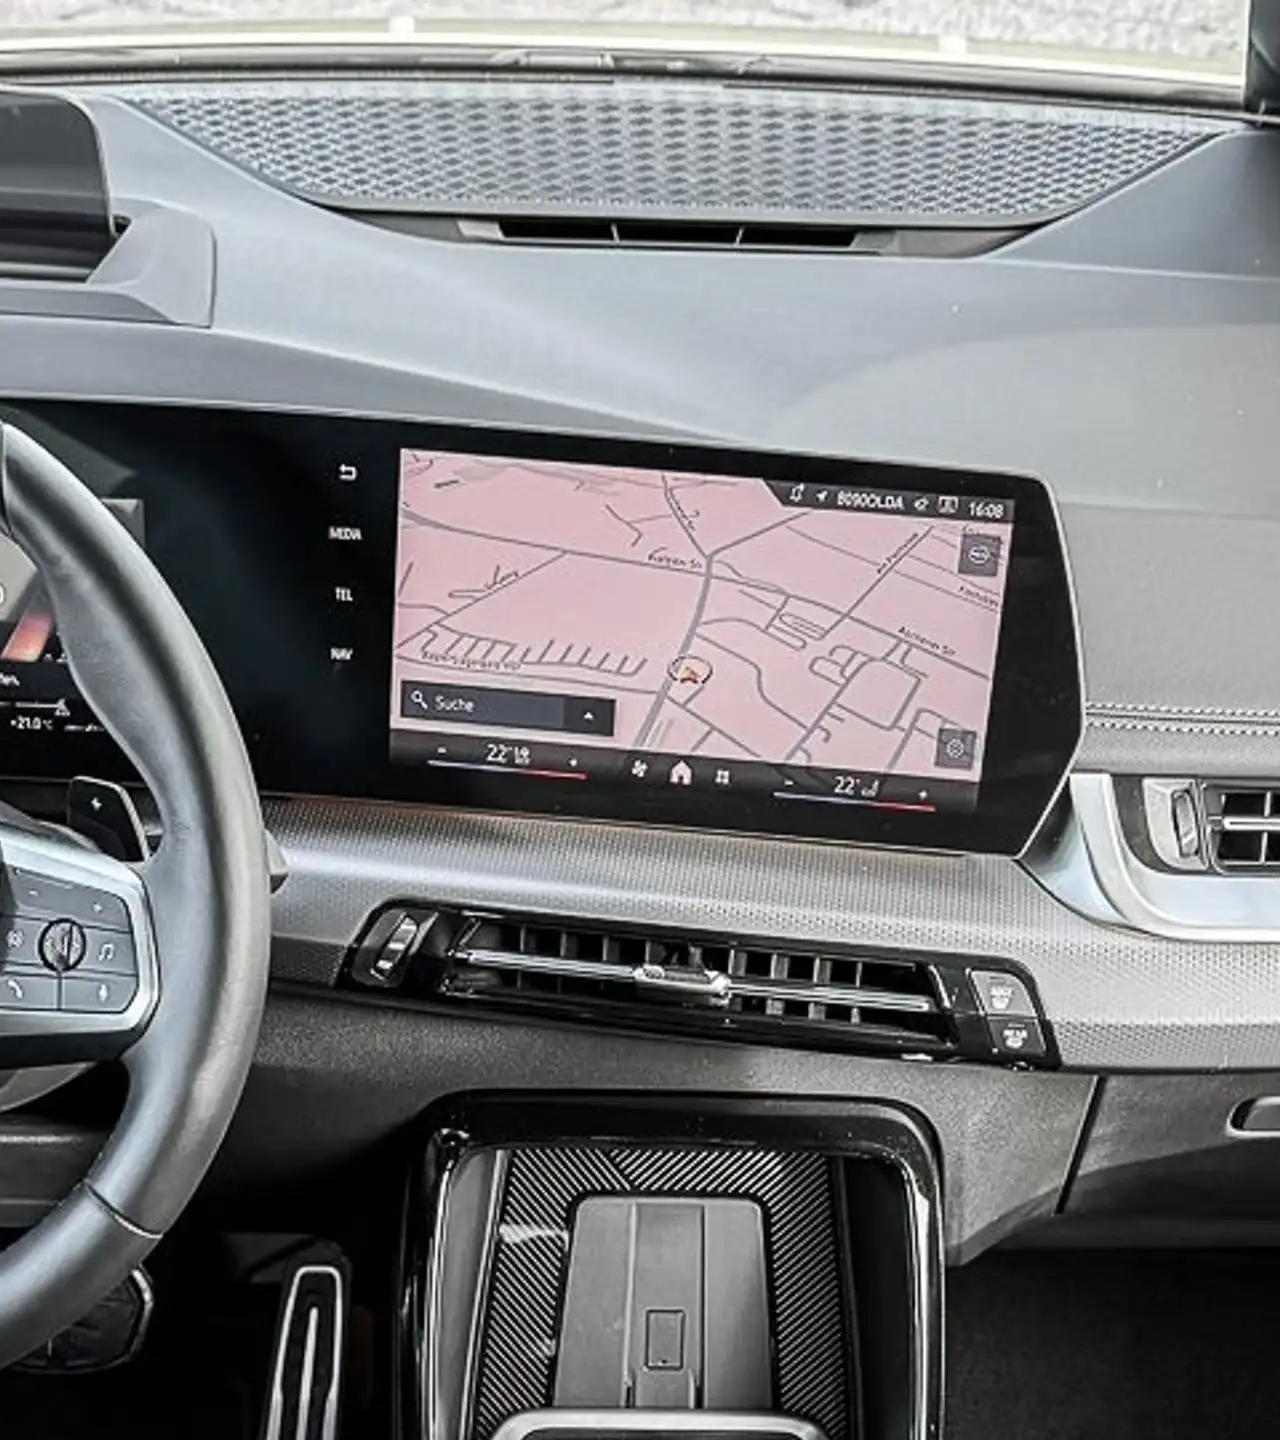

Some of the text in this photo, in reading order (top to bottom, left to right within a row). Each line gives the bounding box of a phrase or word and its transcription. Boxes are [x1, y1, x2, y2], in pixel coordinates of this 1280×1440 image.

[969, 501, 1004, 518] 16:08
[328, 526, 362, 540] MEDIA
[335, 587, 353, 602] TEL
[330, 648, 353, 661] NAV
[435, 695, 475, 713] Suche
